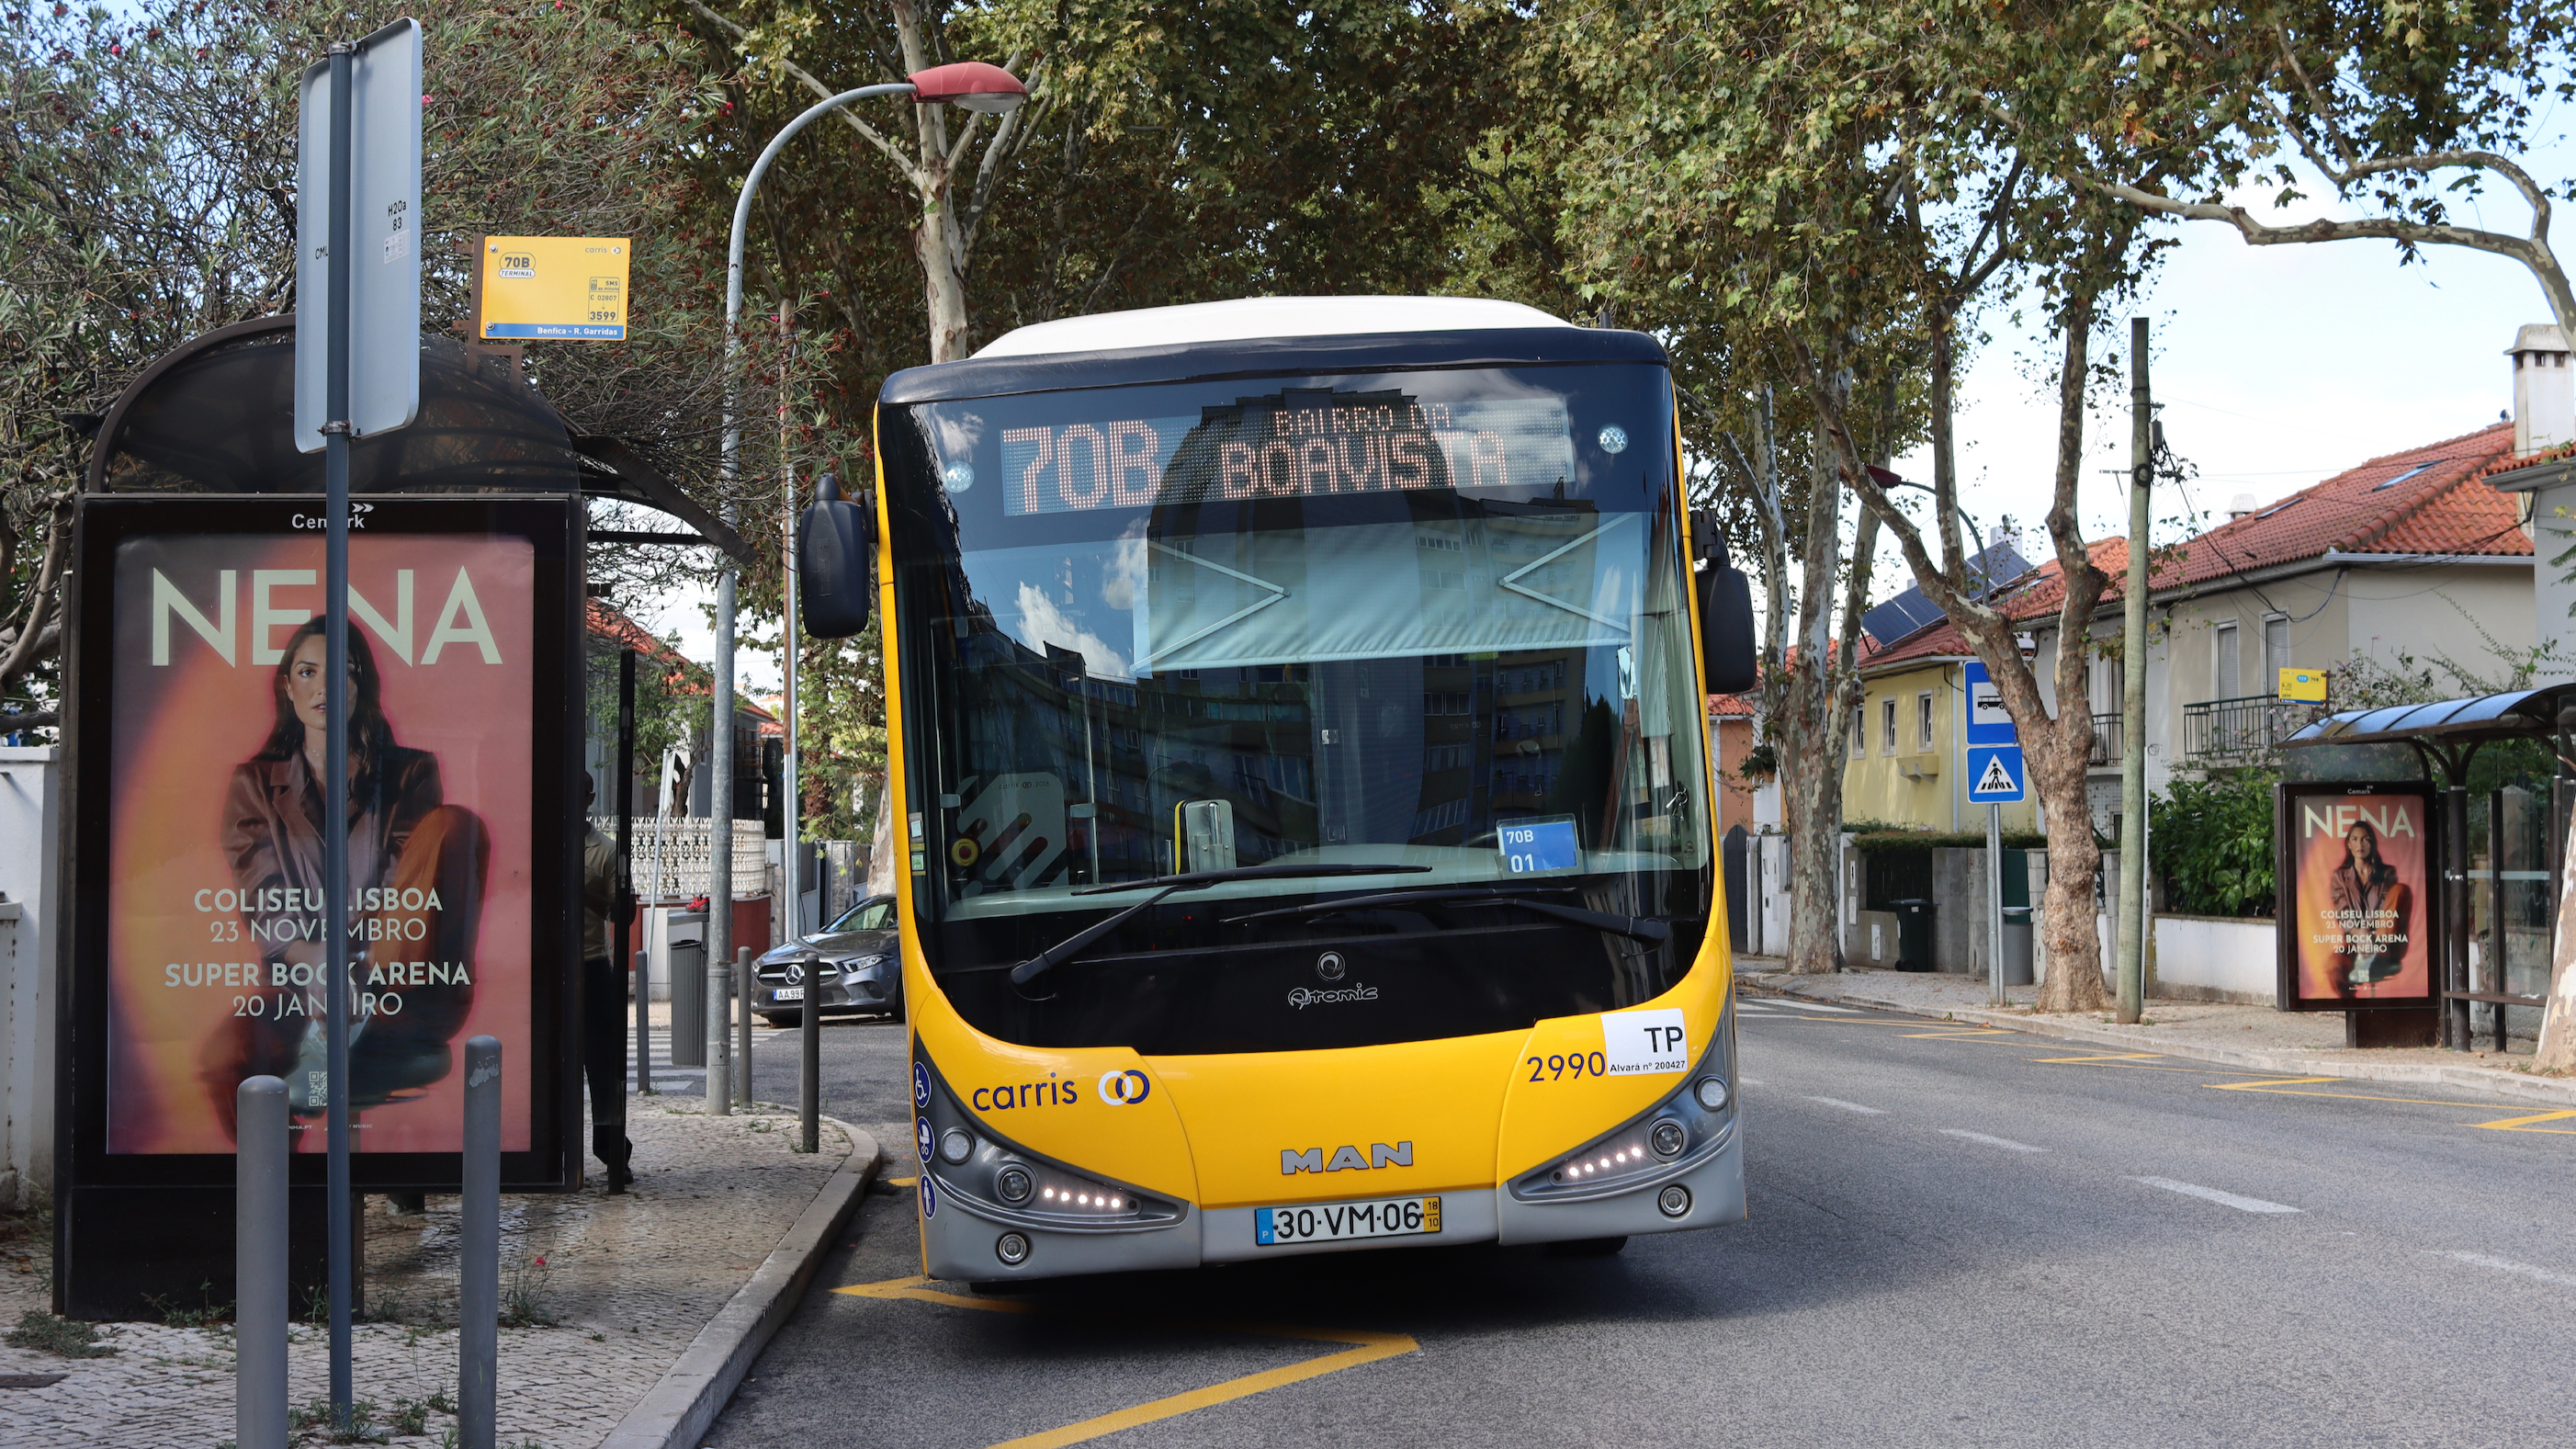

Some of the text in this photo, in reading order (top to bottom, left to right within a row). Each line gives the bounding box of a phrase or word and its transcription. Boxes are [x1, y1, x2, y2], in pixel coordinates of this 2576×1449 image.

[393, 217, 401, 231] 83
[505, 257, 529, 267] 70B
[590, 311, 616, 321] 3599
[1275, 405, 1393, 436] BAIRRO
[1003, 421, 1508, 513] 70B BOAVISTA
[292, 514, 365, 528] Cemrk
[153, 565, 503, 668] NENA
[2305, 805, 2414, 838] NENA
[1507, 830, 1533, 843] 70B
[1511, 854, 1534, 873] 01
[194, 888, 443, 911] COLISEU ISBOA
[2321, 911, 2399, 919] COLISEU LISBOA
[209, 921, 239, 942] 23
[2326, 921, 2394, 929] 23 NOVEMBRO
[2313, 934, 2408, 943] SUPER BOCK ARENA
[2347, 945, 2387, 954] JANEIRO
[164, 963, 259, 987] SUPER
[367, 961, 470, 985] ARENA
[233, 992, 402, 1020] 20 JANIRO
[1644, 1026, 1683, 1052] TP
[1527, 1051, 1605, 1082] 2990
[1610, 1063, 1640, 1072] Alvará
[1655, 1060, 1685, 1070] 200427
[973, 1071, 1078, 1111] carris
[1281, 1141, 1413, 1174] MAN
[1428, 1201, 1438, 1210] 18
[1429, 1218, 1439, 1228] 10
[1262, 1230, 1269, 1239] P
